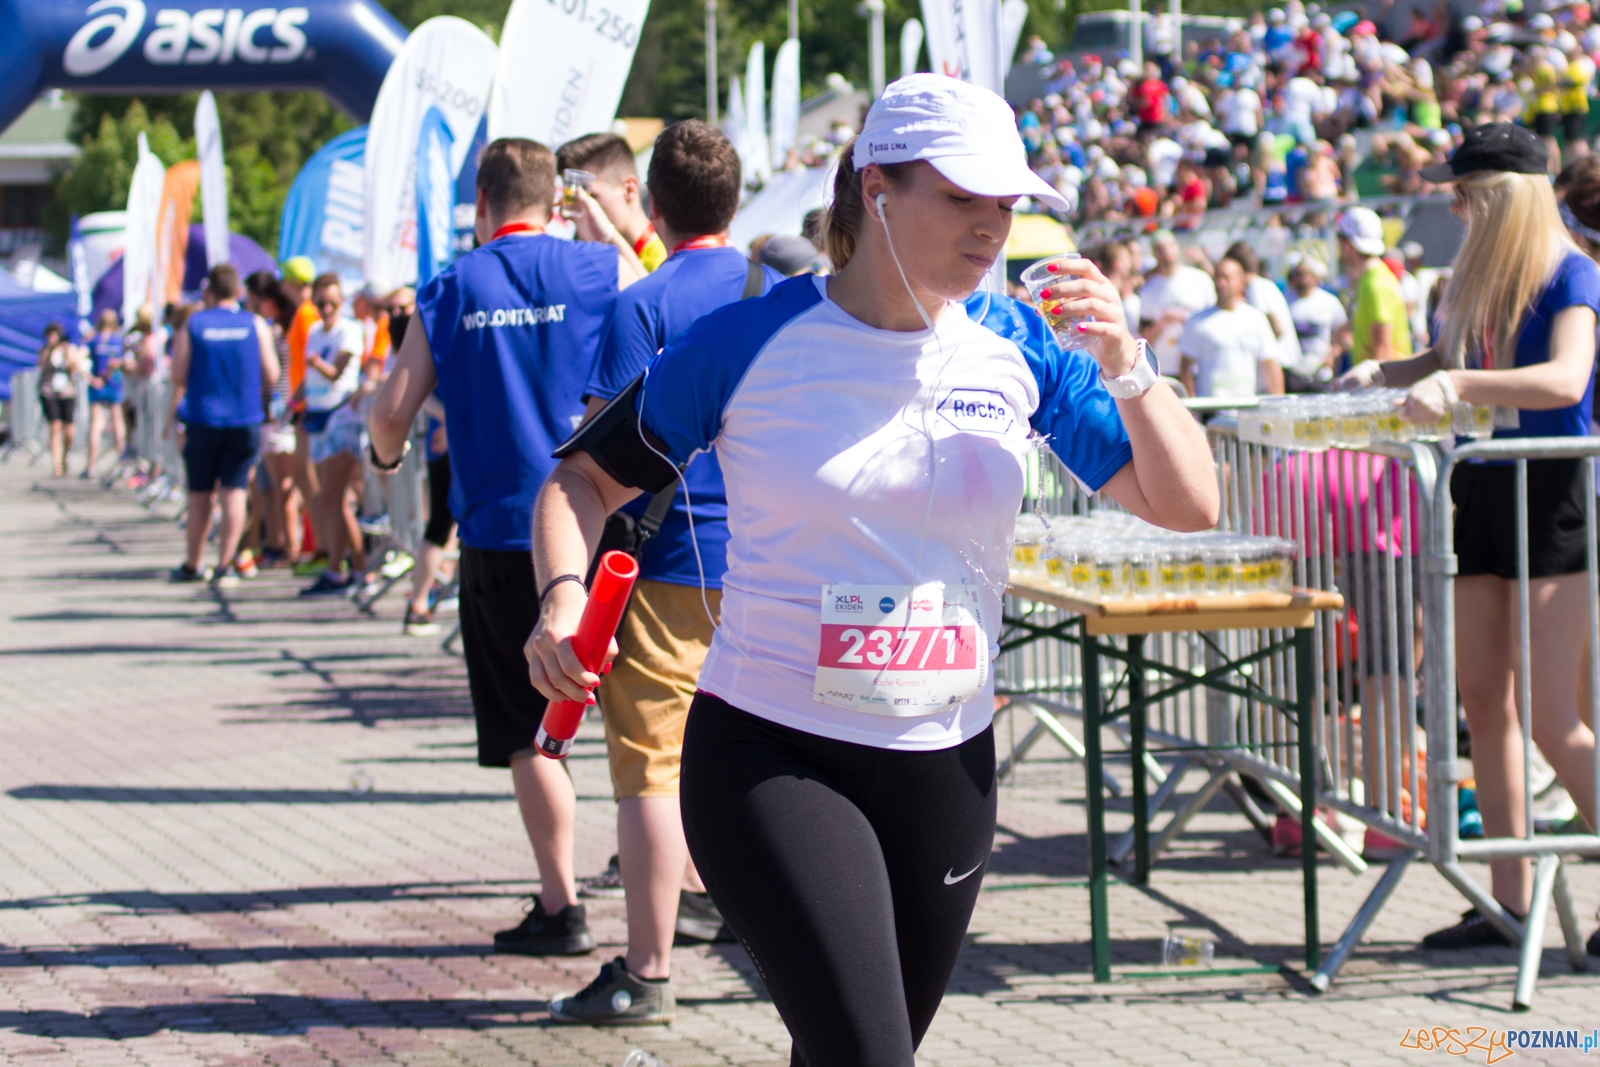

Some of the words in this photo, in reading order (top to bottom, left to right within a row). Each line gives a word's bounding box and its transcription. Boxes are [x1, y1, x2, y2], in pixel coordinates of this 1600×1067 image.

[143, 7, 310, 65] asics
[549, 0, 635, 48] 01-250
[462, 304, 566, 332] WOLONTARIAT
[835, 595, 863, 604] XLPL
[837, 628, 956, 669] 237/1
